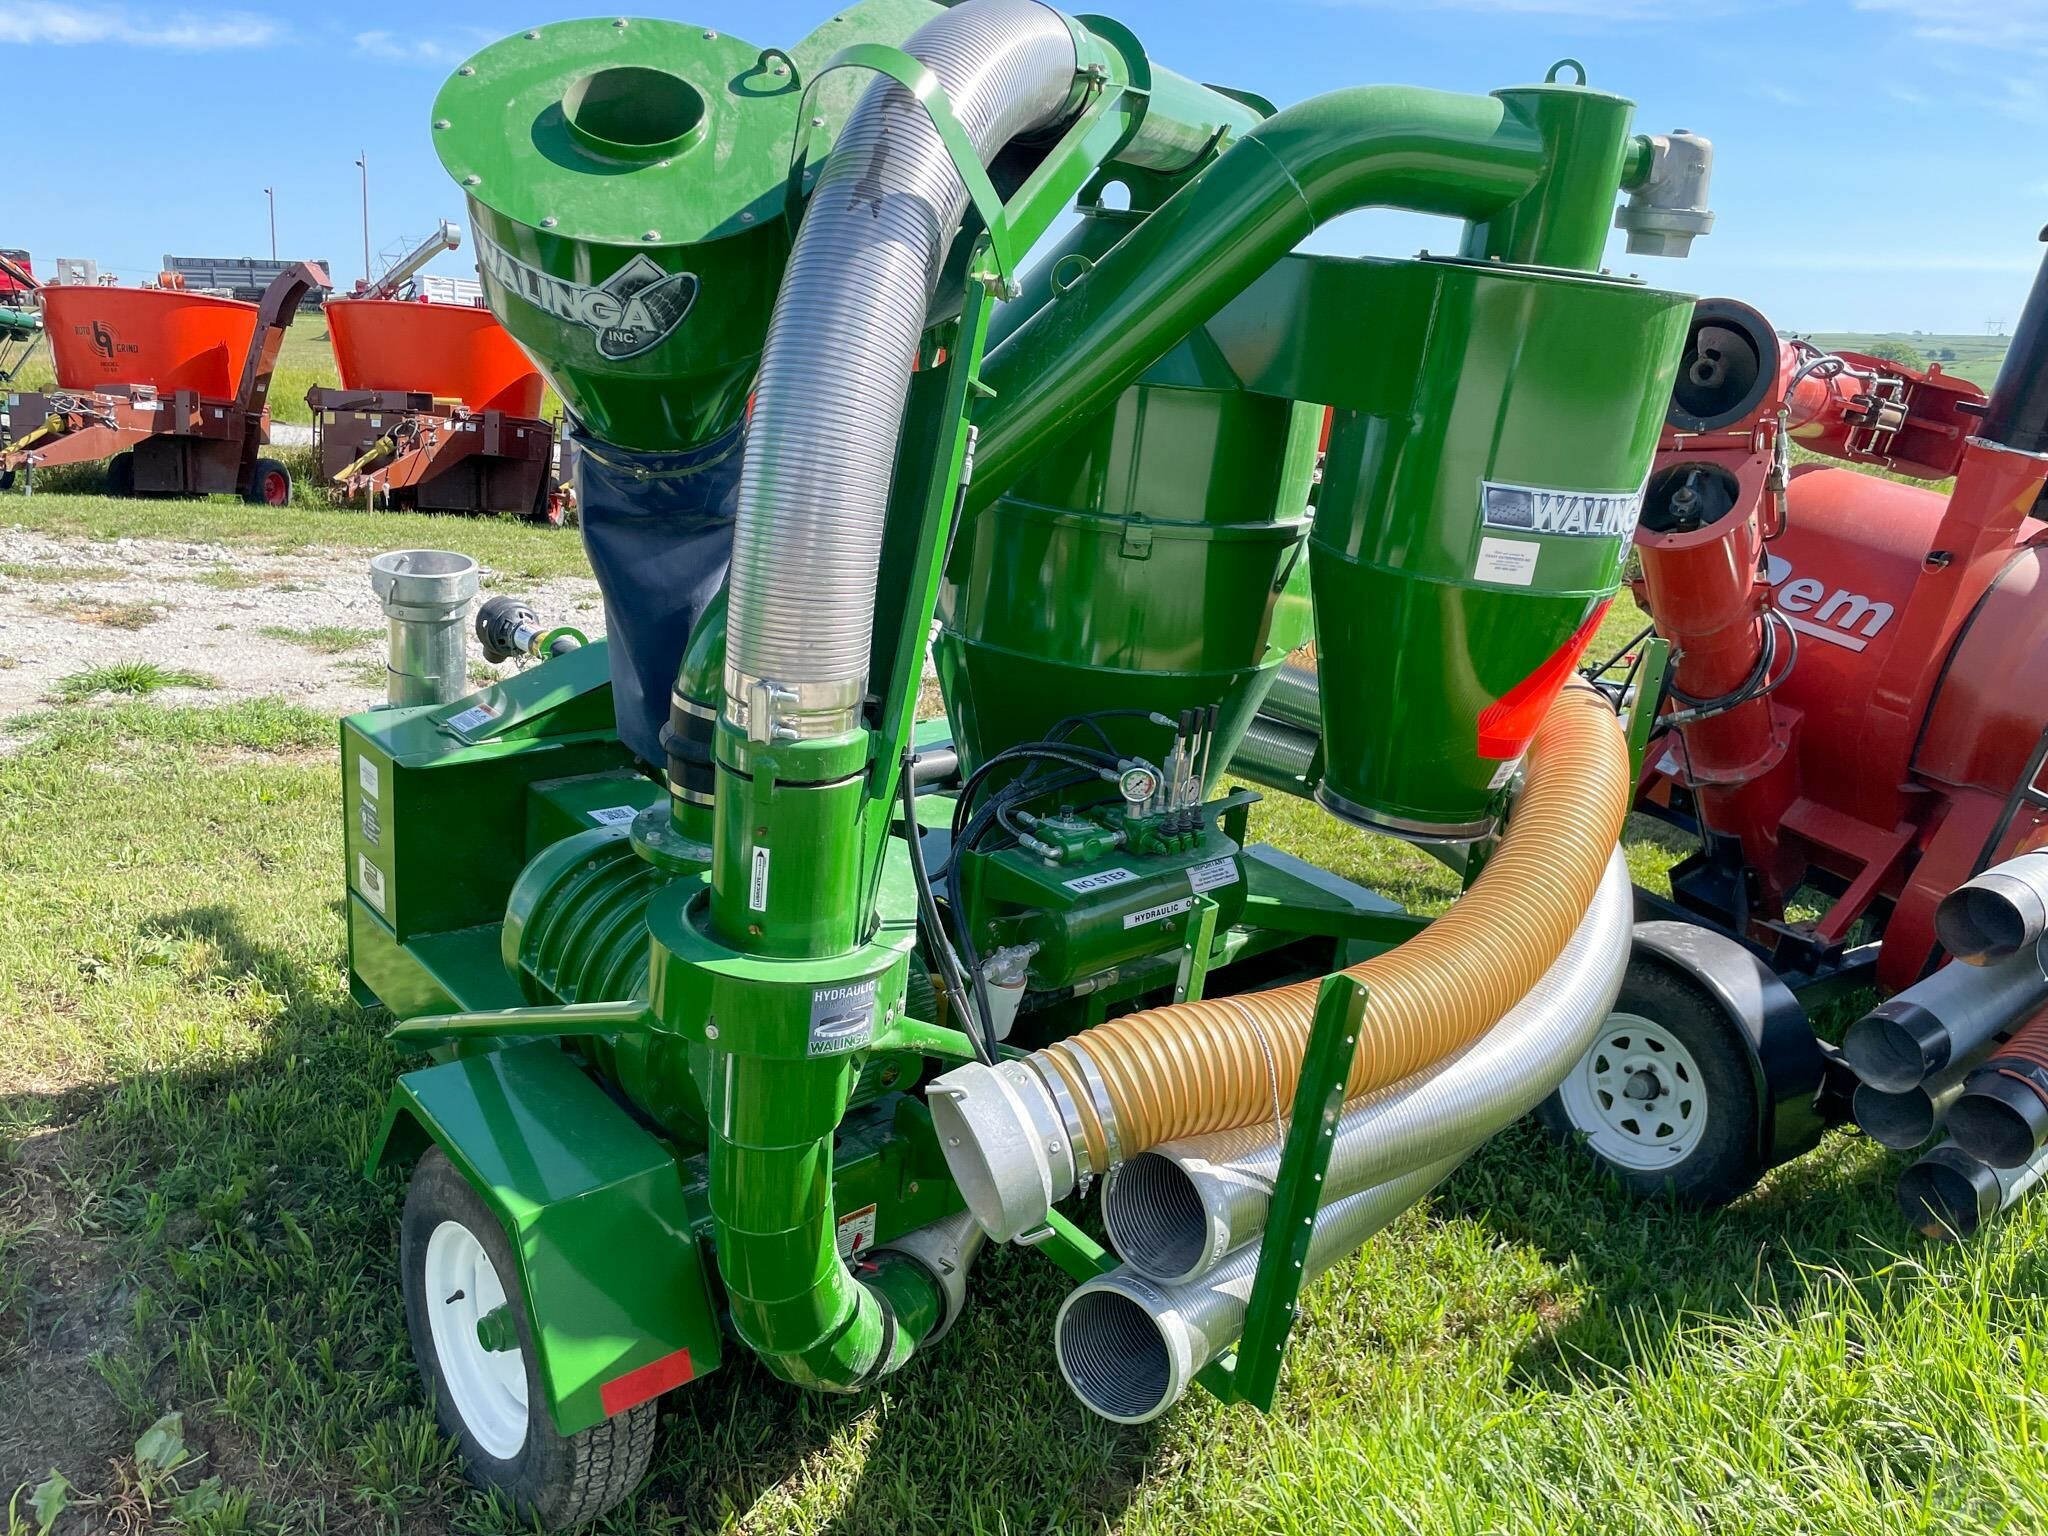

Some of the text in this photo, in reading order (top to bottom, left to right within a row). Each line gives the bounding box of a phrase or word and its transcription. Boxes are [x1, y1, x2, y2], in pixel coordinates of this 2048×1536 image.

[475, 218, 658, 333] WALINGA
[609, 330, 638, 344] INC.
[116, 344, 139, 353] GRIND
[1533, 493, 1640, 532] WALING
[1072, 870, 1127, 891] NO STEP
[1134, 904, 1179, 923] HYDRAULIC
[814, 980, 875, 1002] HYDRAULIC
[810, 1030, 871, 1055] WALINGA
